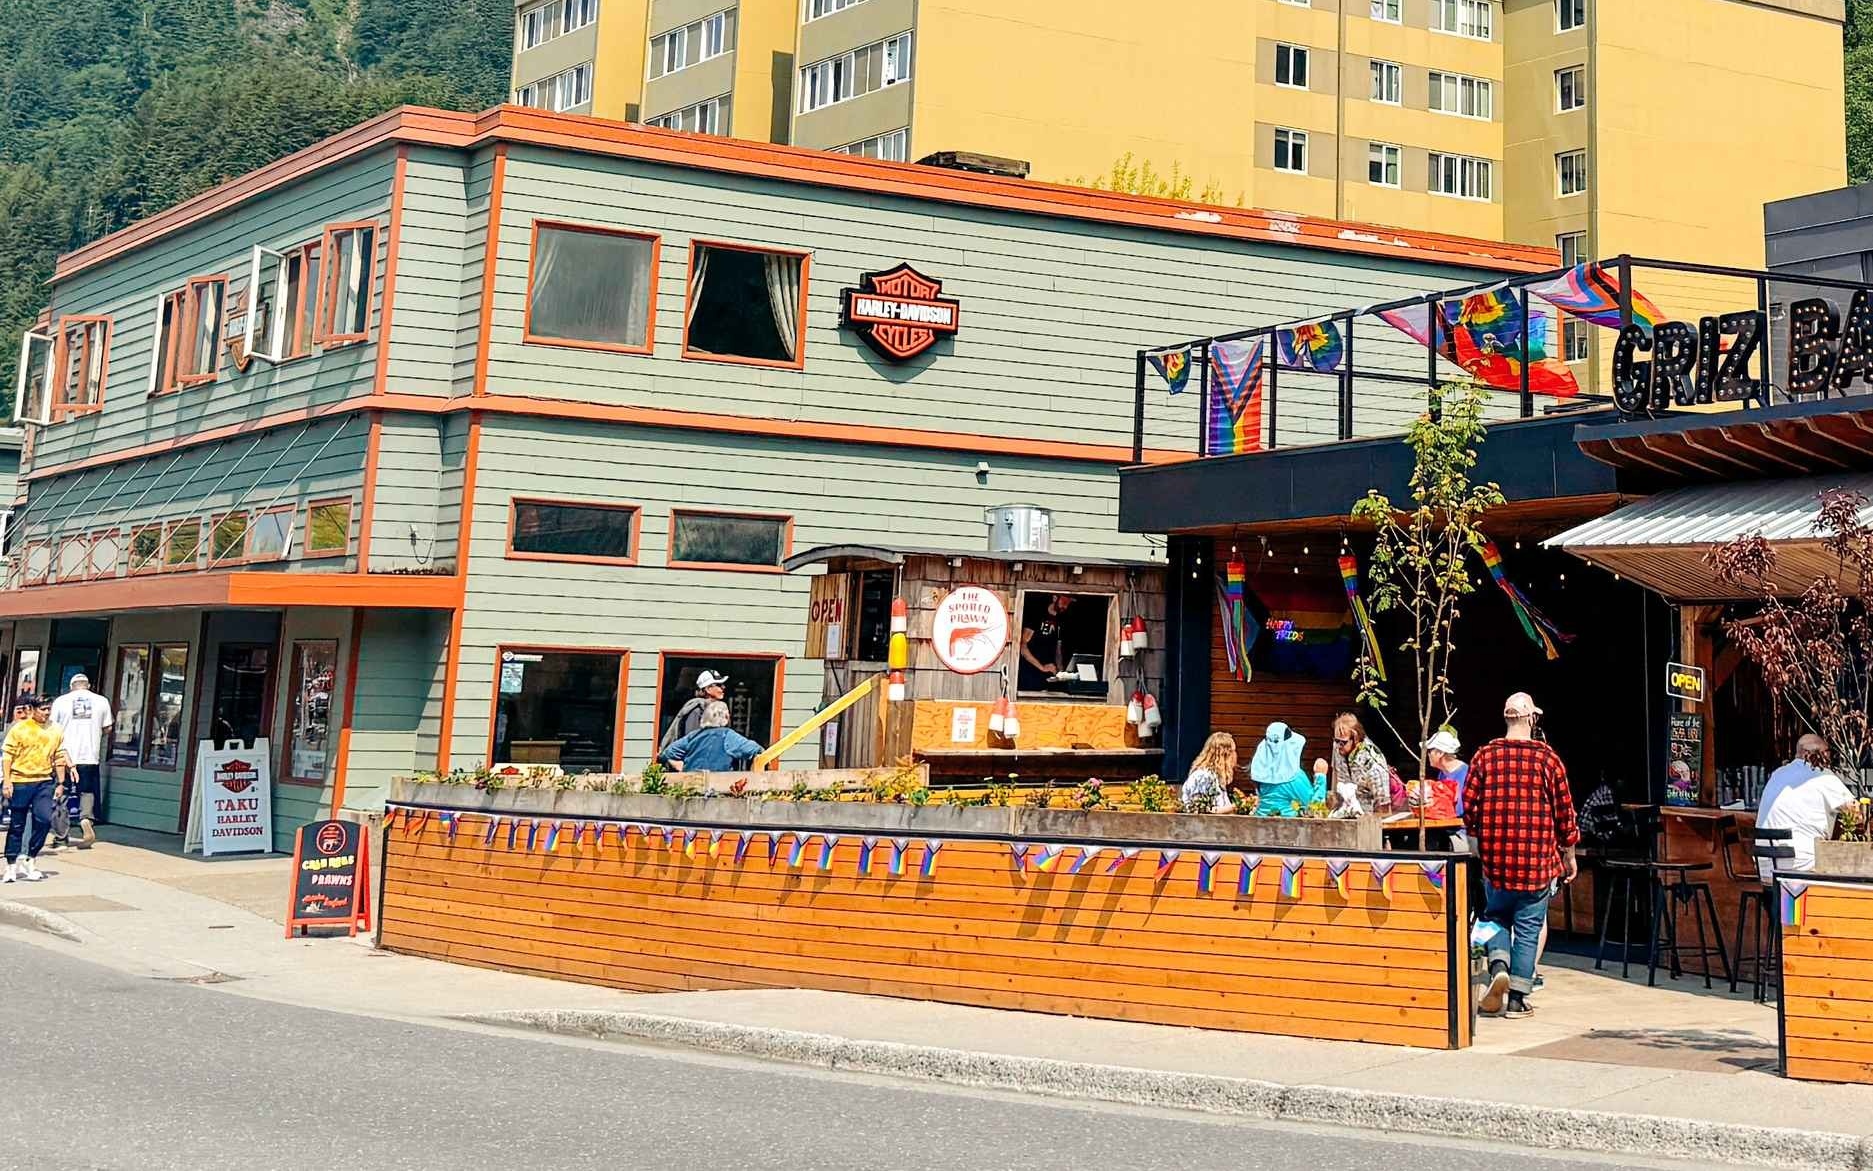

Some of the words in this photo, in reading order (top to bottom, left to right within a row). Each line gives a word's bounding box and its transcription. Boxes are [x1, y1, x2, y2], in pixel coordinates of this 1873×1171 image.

[881, 275, 932, 298] MOTOR
[857, 299, 951, 324] HARLEY-DAVIDSON
[879, 325, 928, 350] CYCLES
[1613, 310, 1765, 414] GRIZ
[962, 592, 979, 601] THE
[812, 597, 842, 622] OPEN
[950, 614, 988, 623] PRAWN
[1671, 672, 1700, 691] OPEN
[214, 798, 258, 811] TAKU
[217, 814, 258, 824] HARLEY
[212, 827, 263, 837] DAVIDSON
[312, 875, 352, 885] PRAWNS
